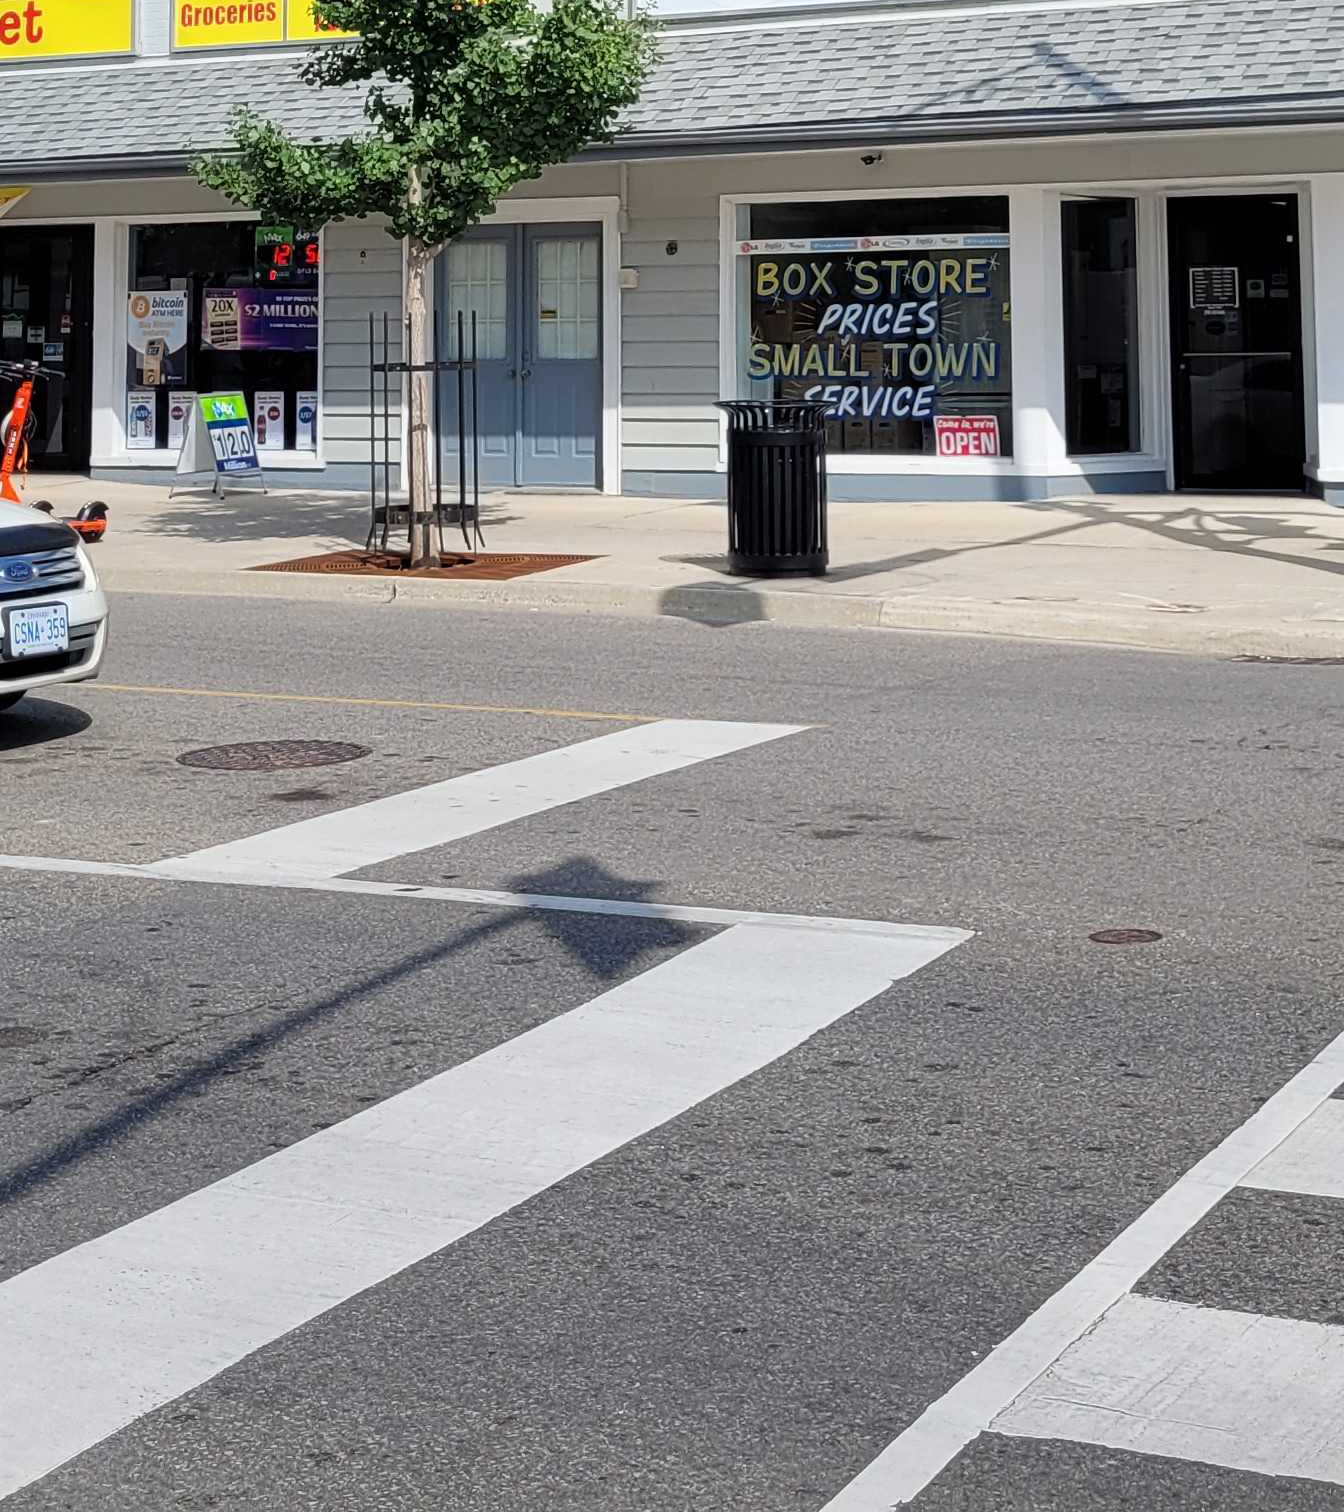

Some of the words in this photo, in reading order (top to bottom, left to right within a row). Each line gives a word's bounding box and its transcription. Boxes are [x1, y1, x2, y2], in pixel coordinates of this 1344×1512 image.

[181, 0, 276, 27] Groceries
[757, 261, 833, 296] BOX
[854, 258, 987, 295] STORE
[151, 296, 184, 308] bitcoin
[167, 309, 184, 317] HERE
[211, 299, 235, 313] 20X
[244, 304, 261, 317] $2
[262, 303, 320, 318] MILLION
[816, 301, 938, 335] PRICES
[749, 343, 870, 377] SMALL
[882, 342, 996, 377] TOWN
[941, 432, 996, 454] OPEN
[14, 621, 40, 644] CSNA
[47, 617, 66, 640] 359
